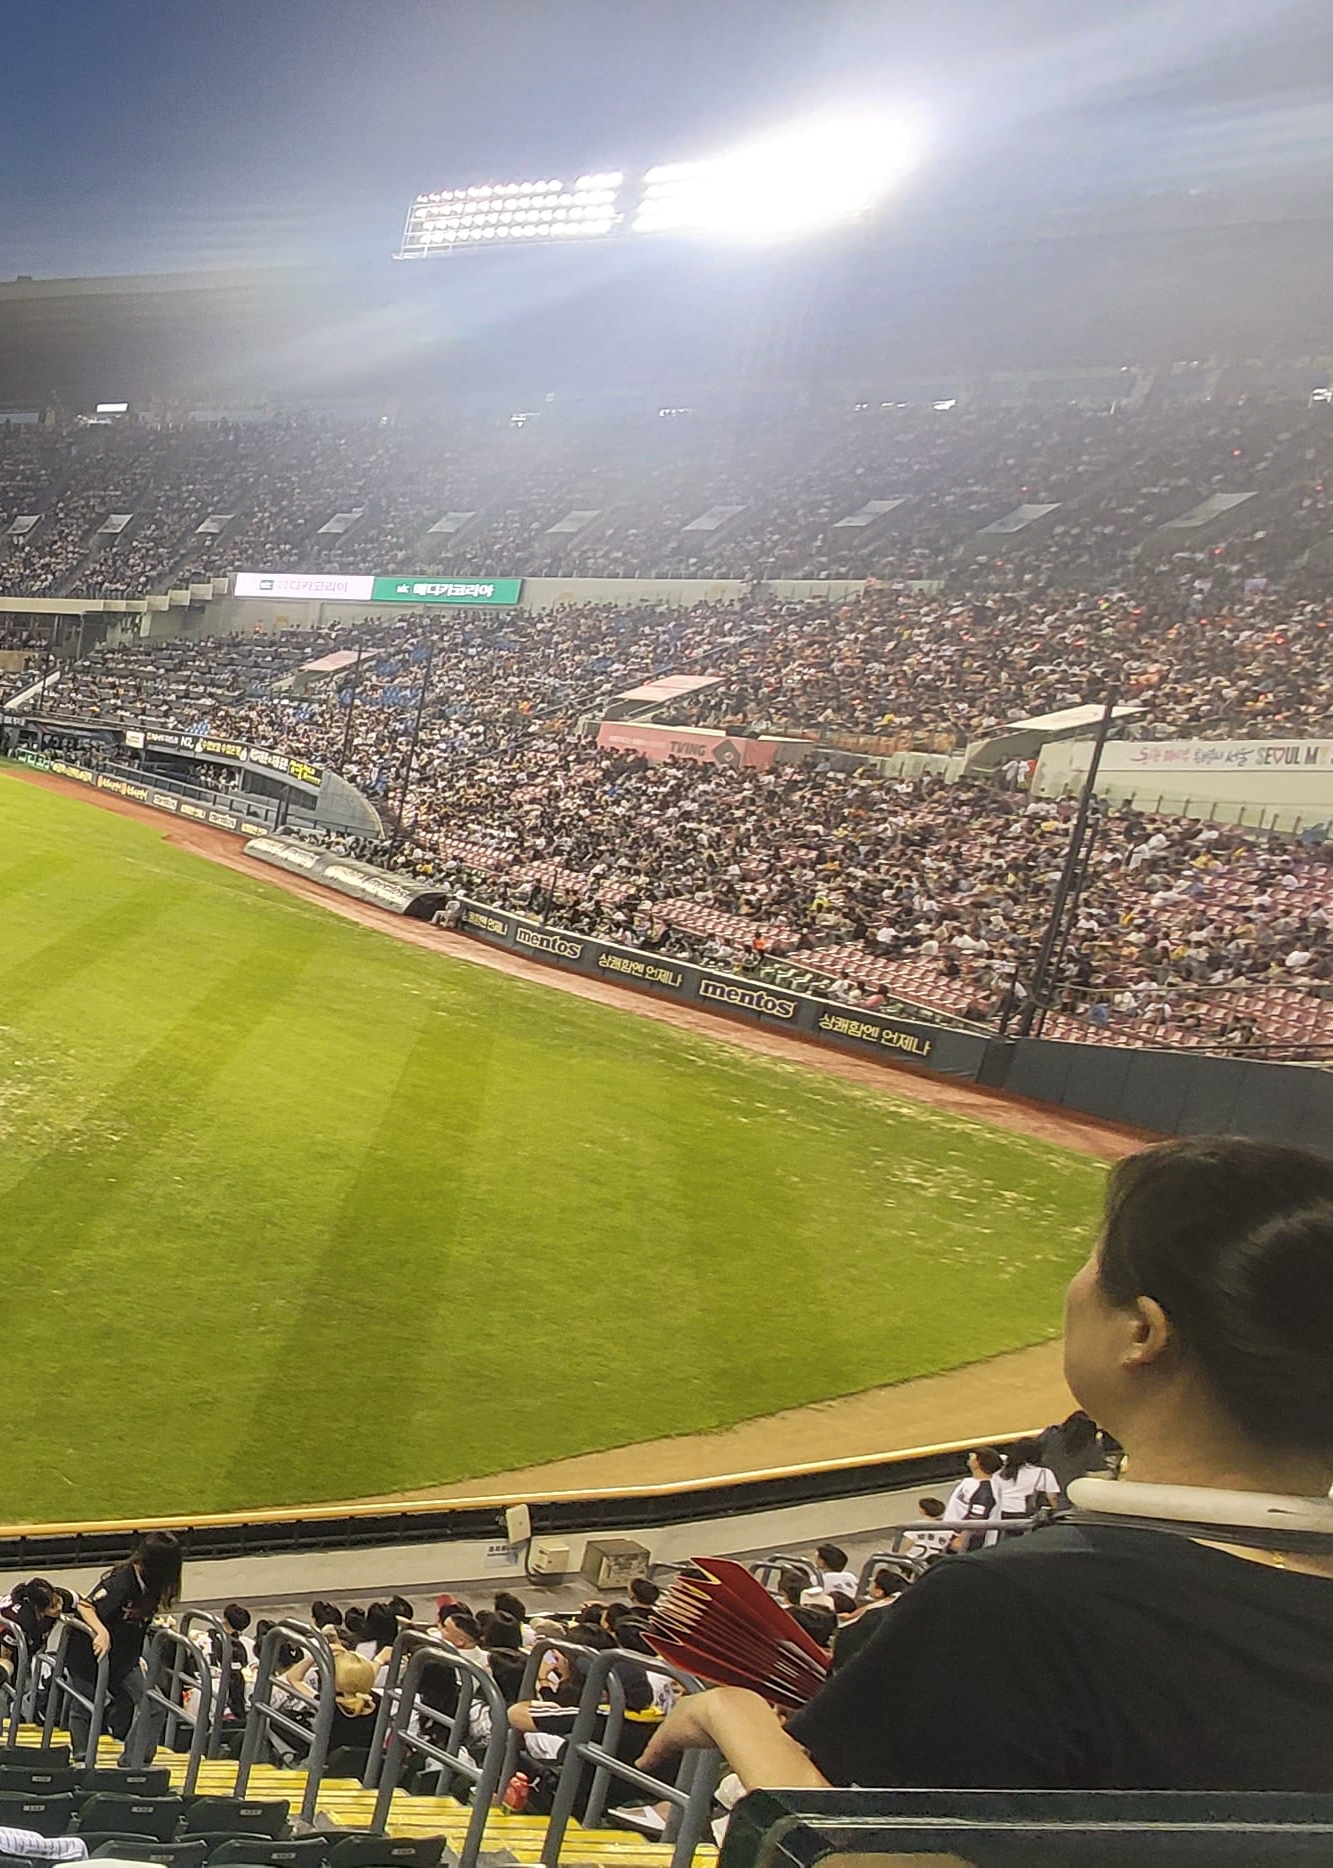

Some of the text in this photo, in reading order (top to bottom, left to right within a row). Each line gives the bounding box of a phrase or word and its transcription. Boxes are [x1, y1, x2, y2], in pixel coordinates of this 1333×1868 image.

[669, 740, 707, 757] TVING
[515, 926, 584, 961] mentos
[645, 964, 683, 988] 언제나
[699, 979, 798, 1019] mentos
[818, 1011, 932, 1056] 상쾌함엔 언제나
